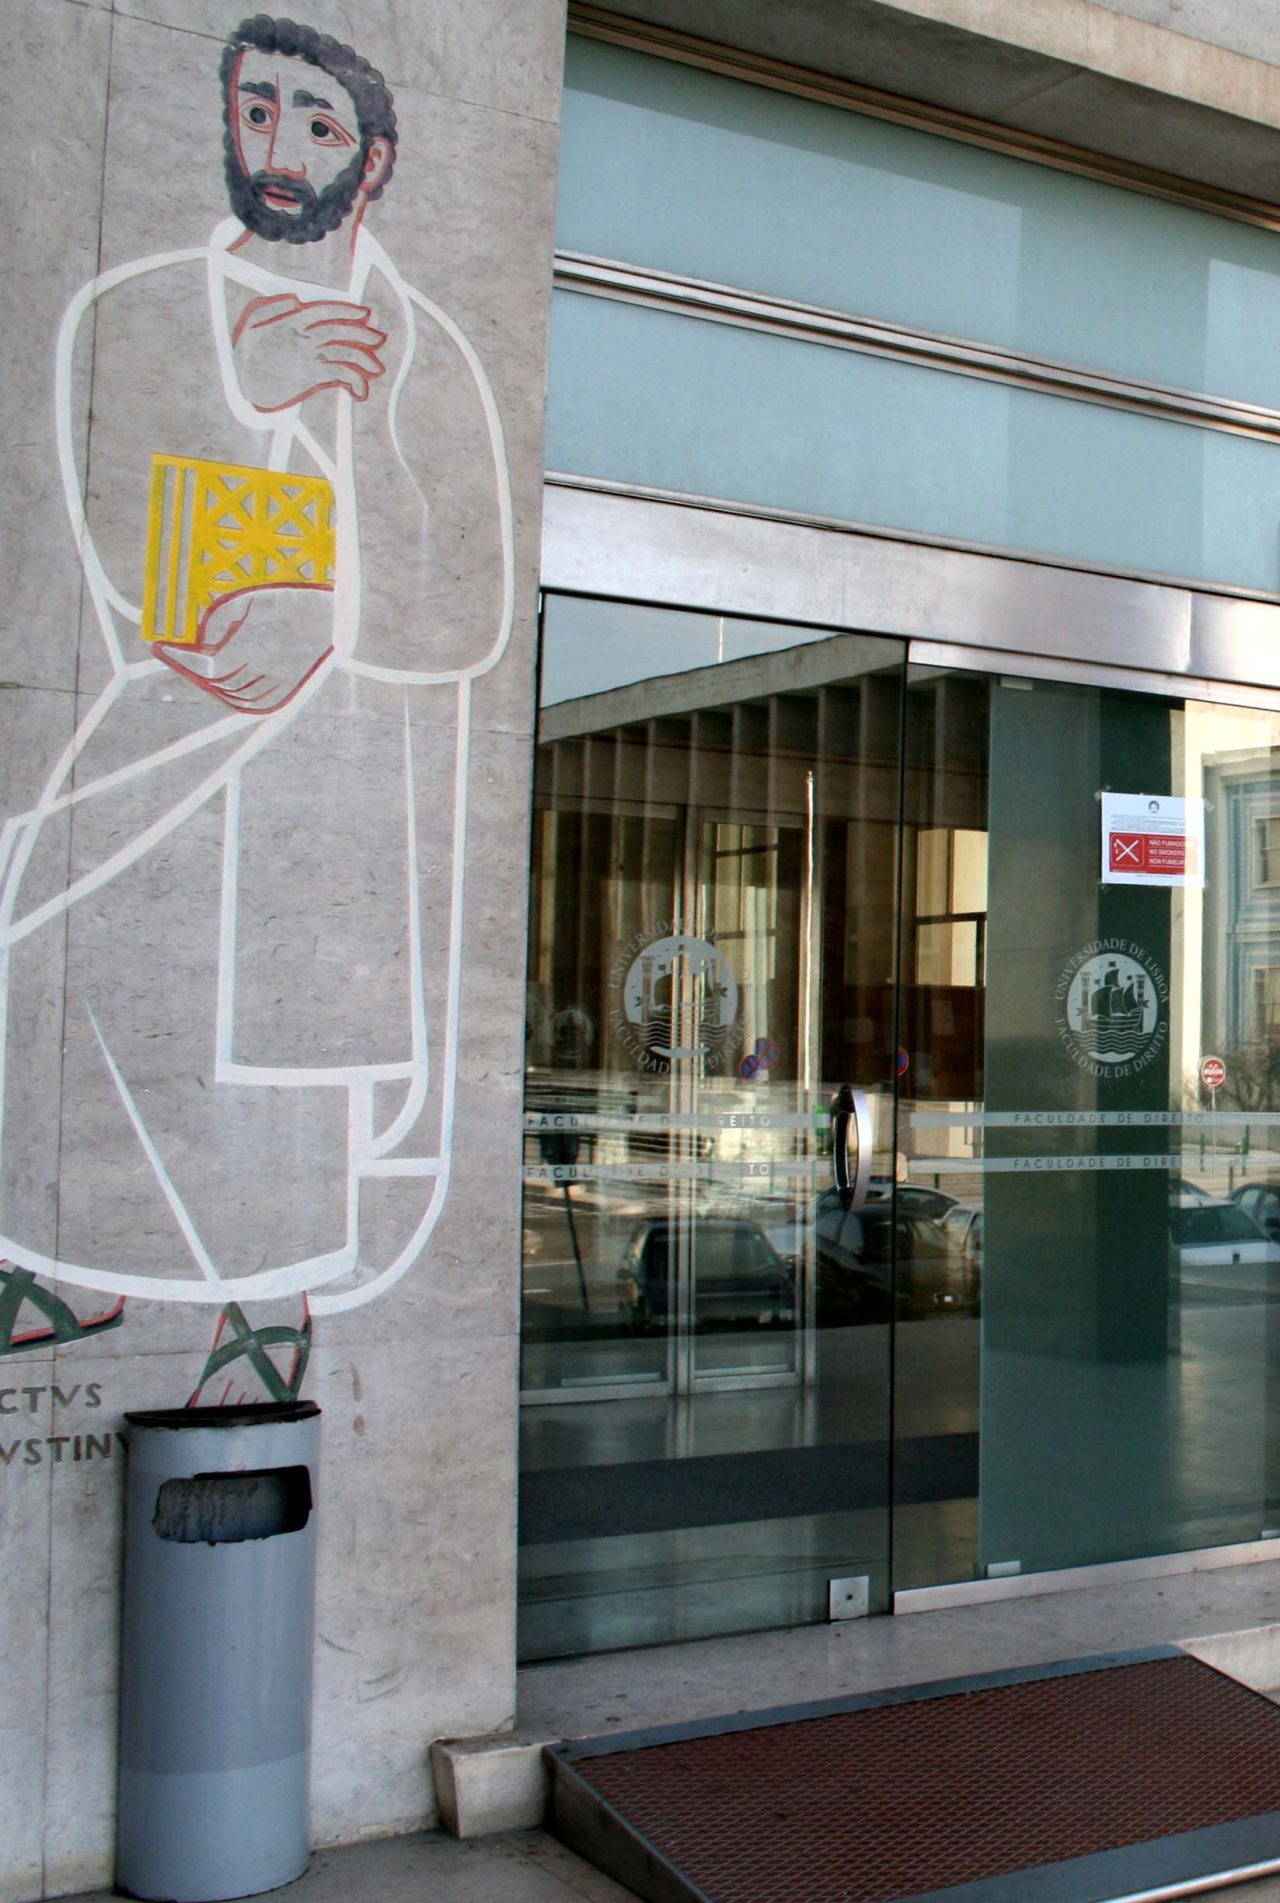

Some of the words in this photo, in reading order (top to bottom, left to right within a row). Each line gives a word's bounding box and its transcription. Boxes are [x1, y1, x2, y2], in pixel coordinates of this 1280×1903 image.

[1055, 937, 1127, 1001] UNIVERSIDADE
[1129, 942, 1146, 961] DE
[1144, 958, 1170, 1004] LISBOA
[1055, 1018, 1113, 1079] FACULDADE
[1114, 1064, 1132, 1079] DE
[1132, 1020, 1169, 1073] DIREITO
[1014, 1113, 1107, 1124] FACULDADE
[1117, 1113, 1132, 1124] DE
[1014, 1158, 1106, 1169] FACULDADE
[1117, 1157, 1131, 1167] DE
